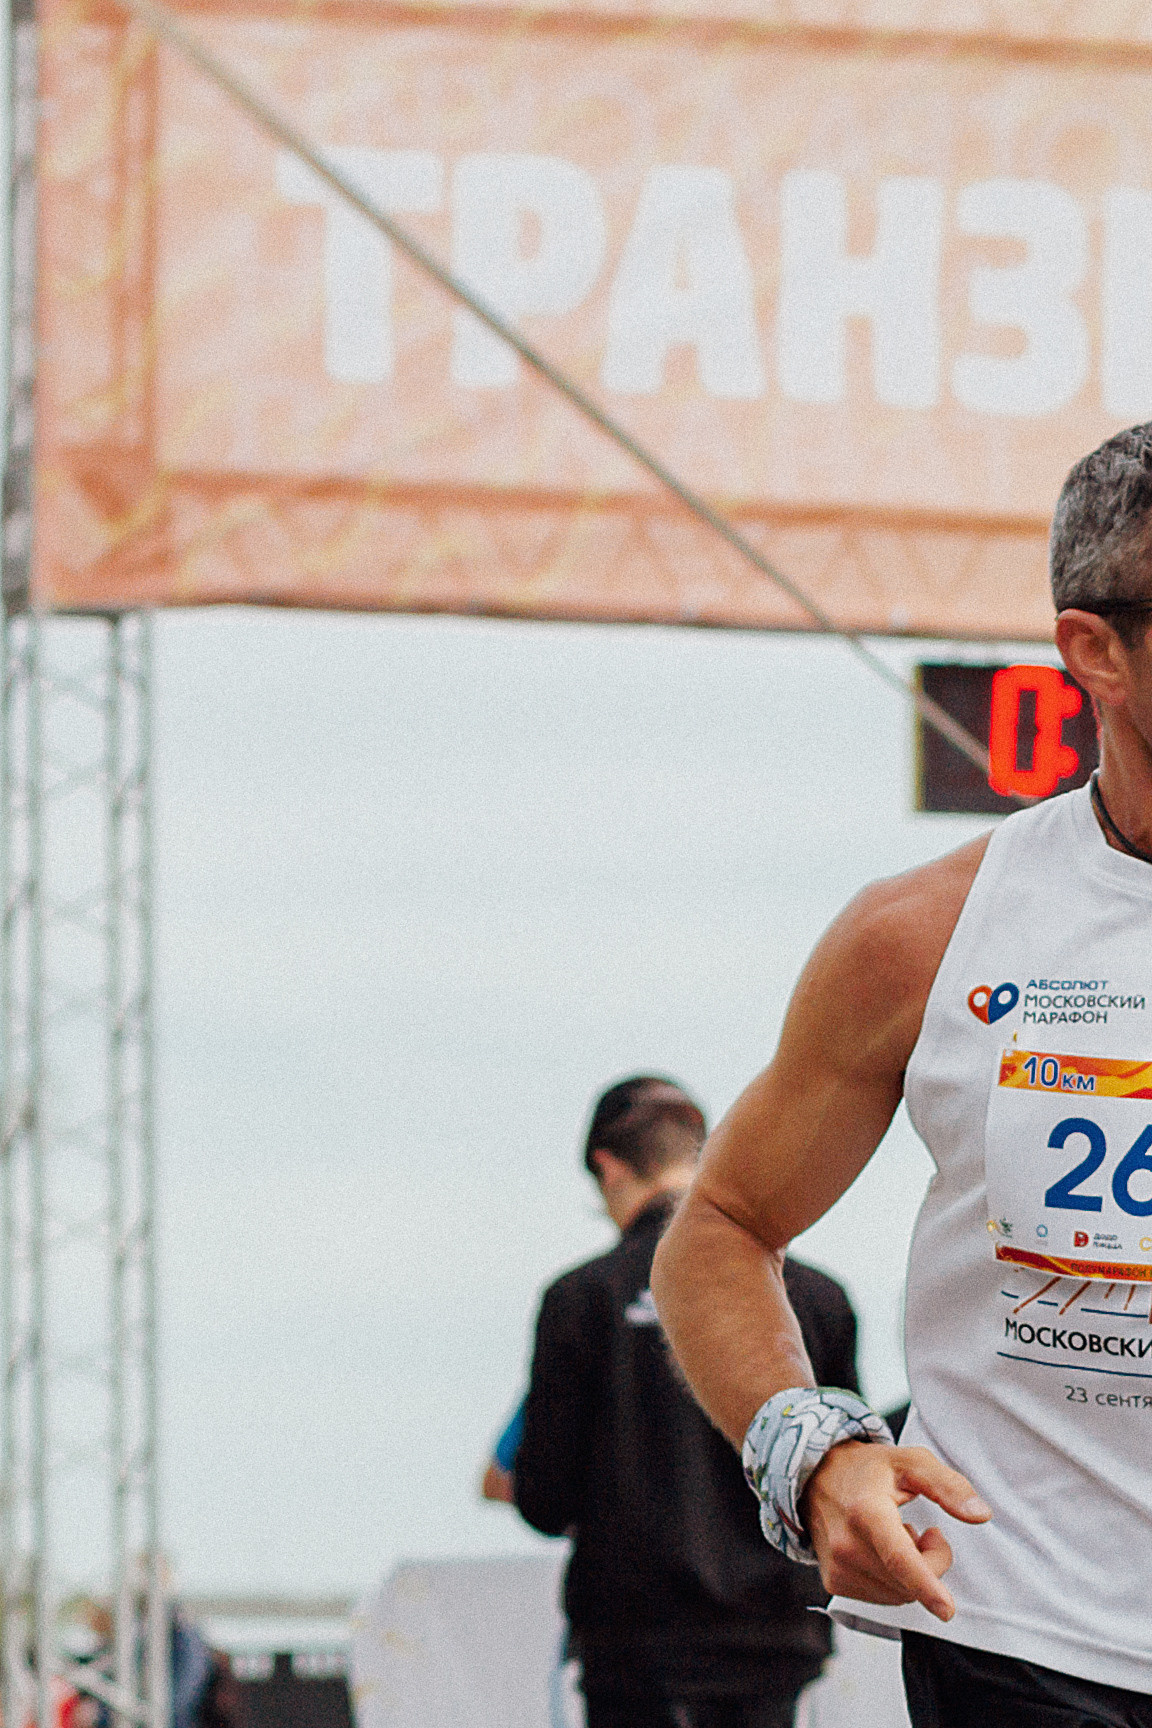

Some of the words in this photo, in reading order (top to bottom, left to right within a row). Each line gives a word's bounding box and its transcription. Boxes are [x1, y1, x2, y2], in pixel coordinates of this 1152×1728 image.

[1024, 993, 1146, 1010] МОСКОВСКИЙ
[1022, 1010, 1108, 1024] МАРАФОН
[1064, 1385, 1088, 1403] 23
